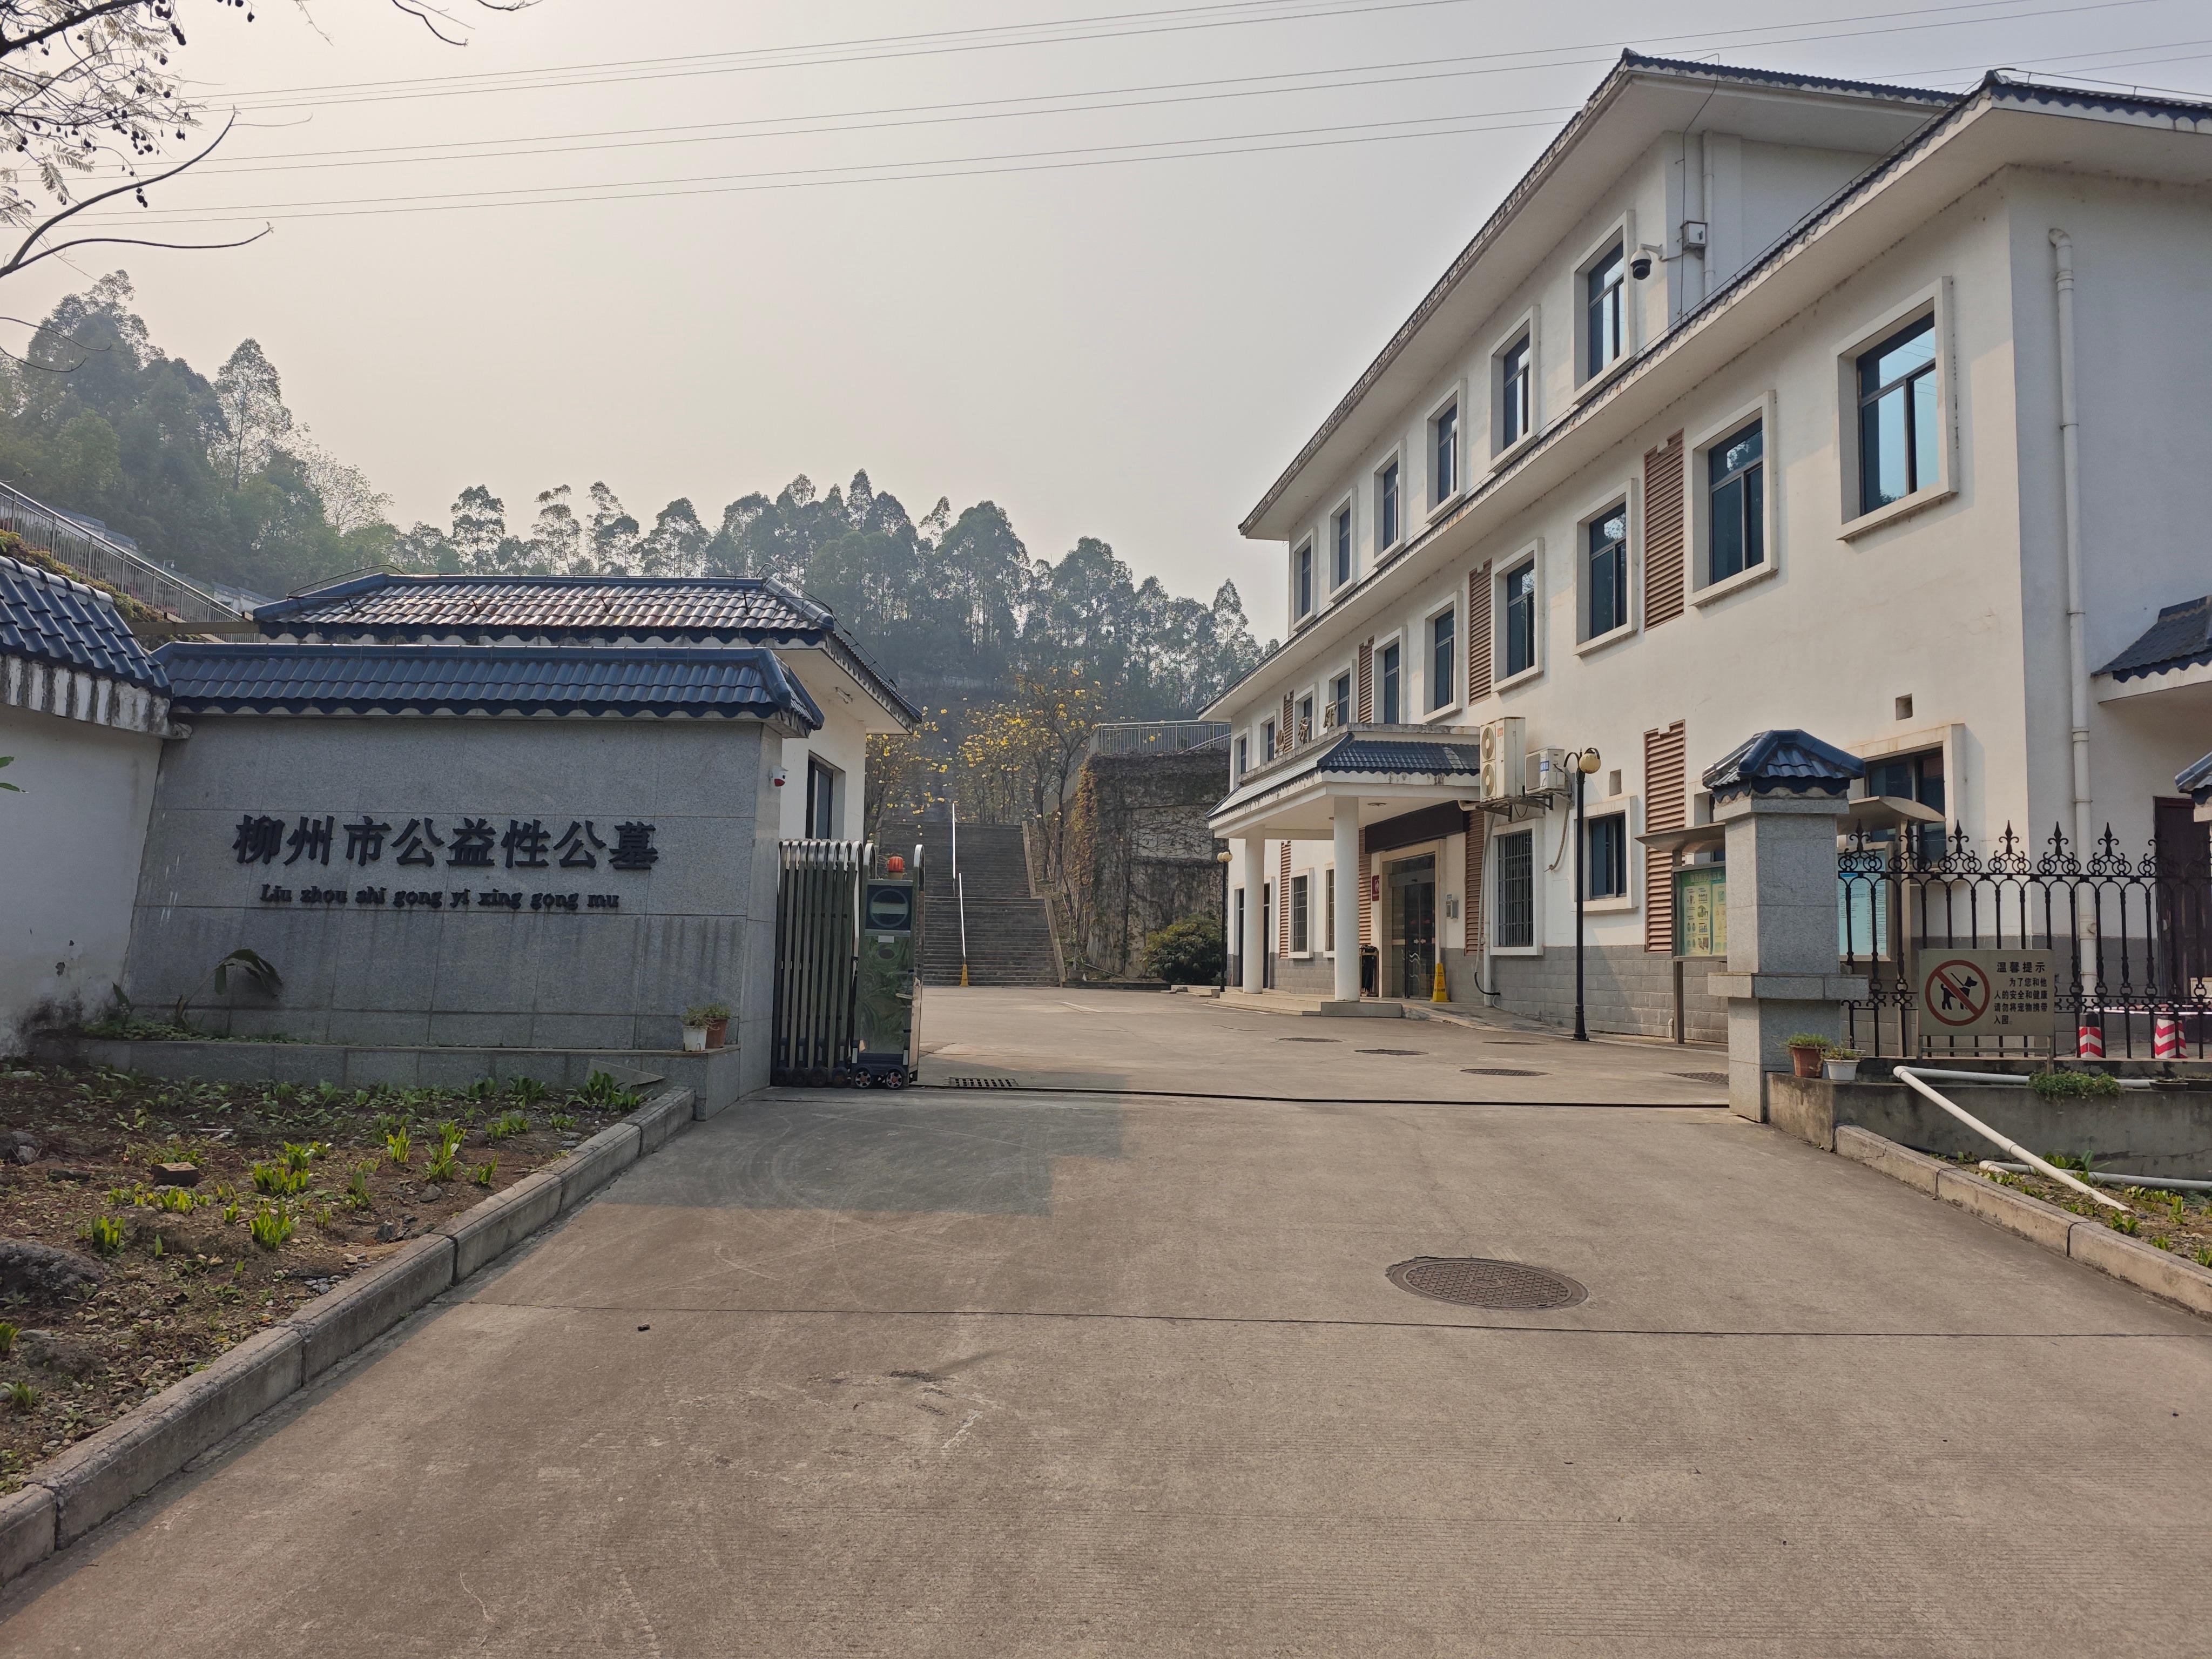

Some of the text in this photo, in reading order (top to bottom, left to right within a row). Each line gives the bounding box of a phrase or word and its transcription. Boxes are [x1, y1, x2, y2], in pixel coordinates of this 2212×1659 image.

[232, 814, 659, 870] 柳州市公益性公墓
[260, 884, 619, 911] Liu zhou shi gong yi xing gong mu
[1997, 961, 2045, 973] 温馨提示
[2009, 977, 2047, 987] 为了您和他
[1994, 989, 2048, 1000] 人的安全和健康
[1994, 1002, 2048, 1013] 请勿将宠物携带
